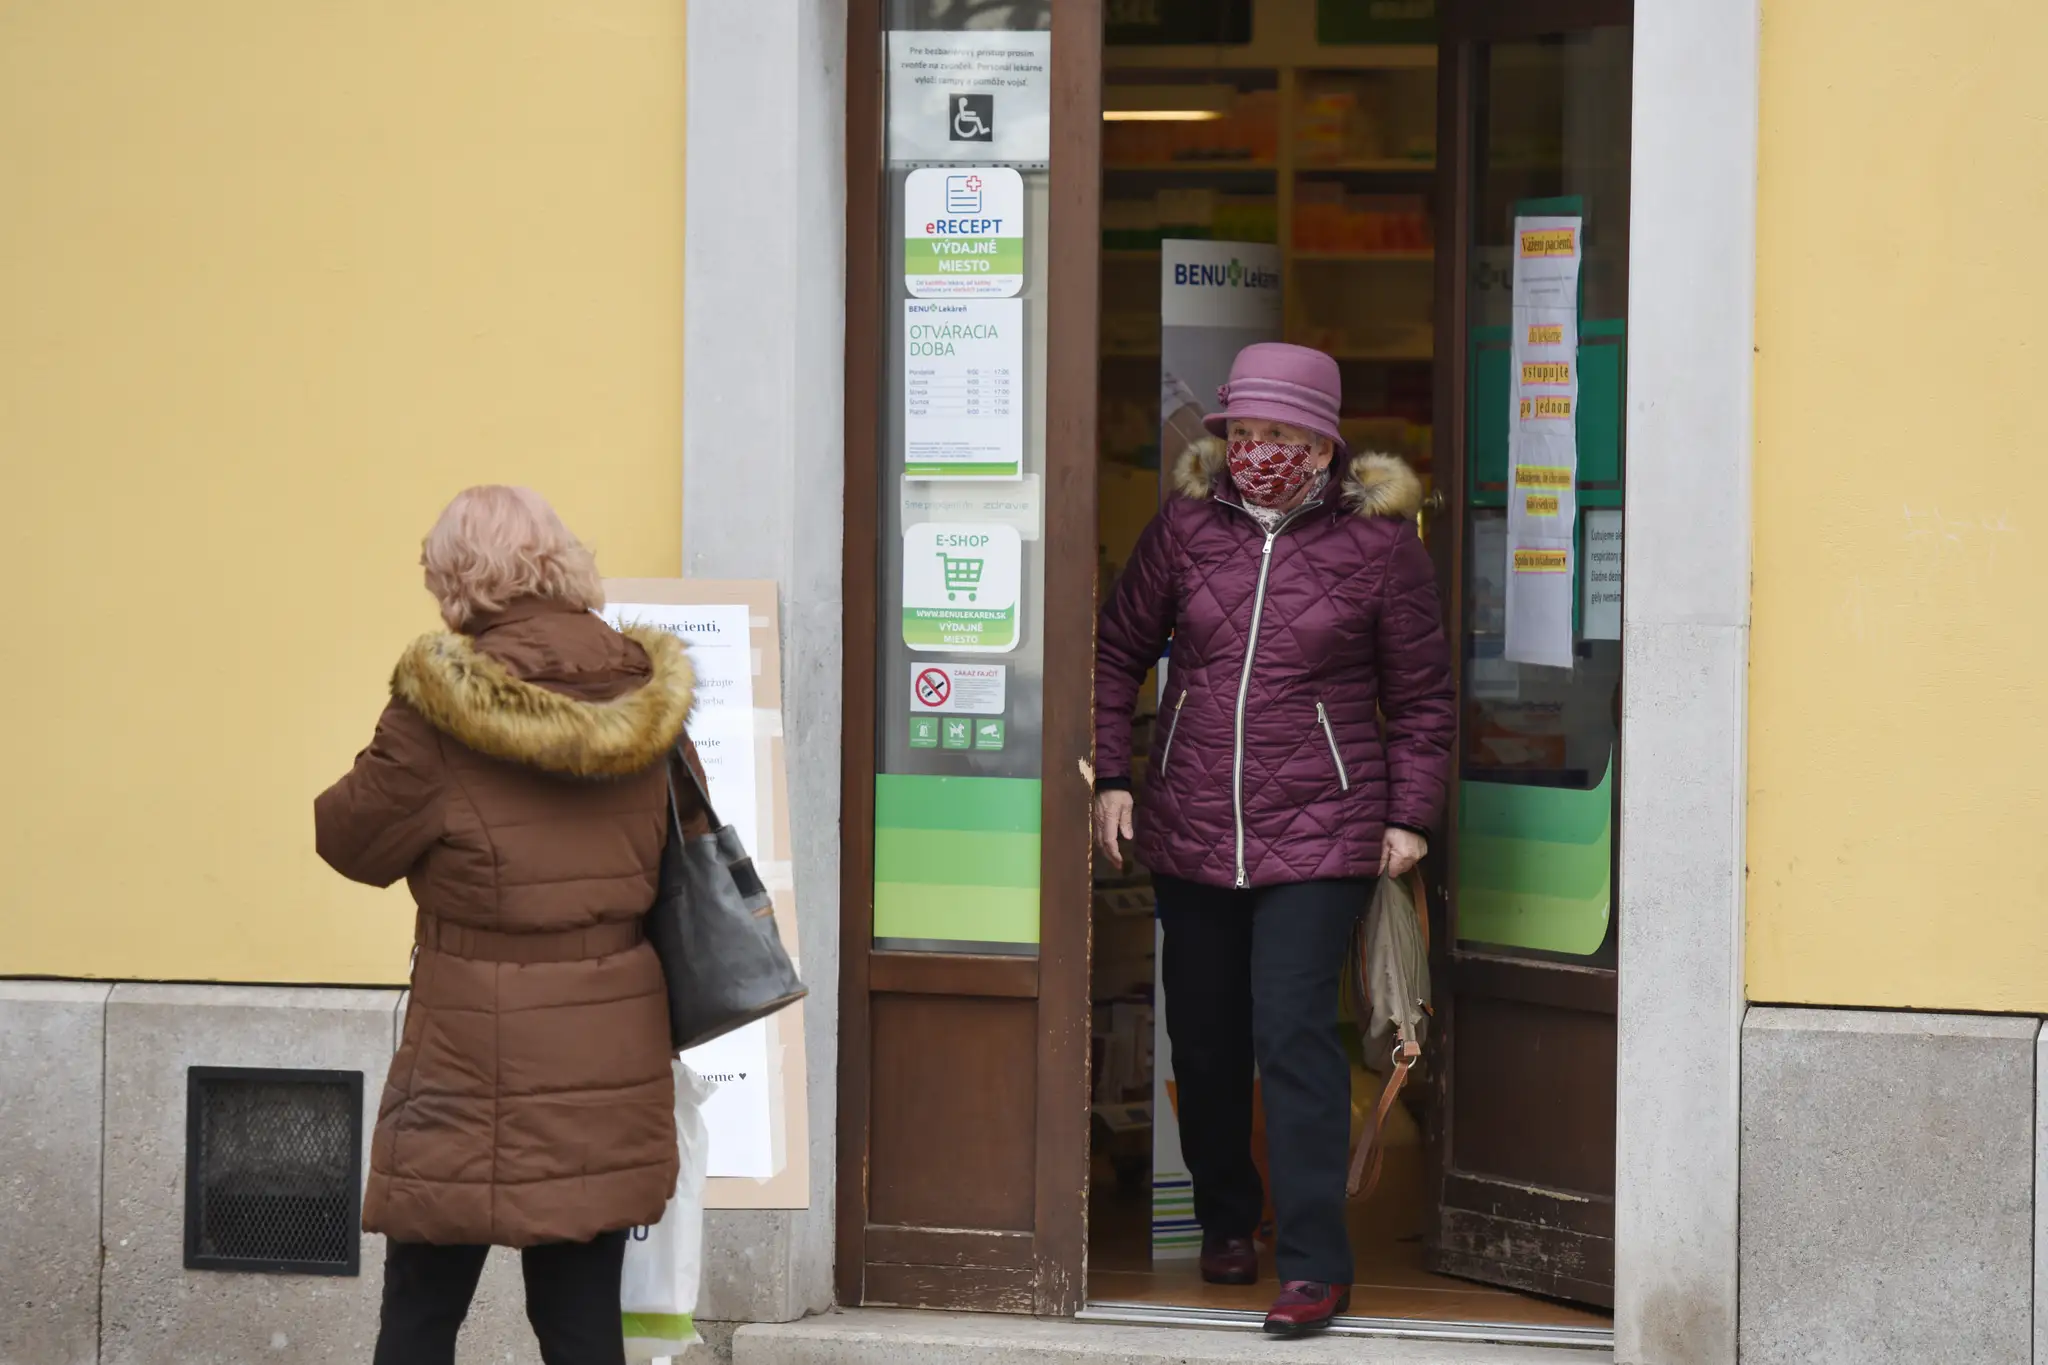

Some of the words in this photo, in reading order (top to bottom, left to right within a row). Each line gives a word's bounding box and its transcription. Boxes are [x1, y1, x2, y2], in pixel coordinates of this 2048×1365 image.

[926, 219, 1003, 234] eRECEPT
[931, 239, 998, 254] VÝDAJNÉ
[938, 259, 990, 272] MIESTO
[1175, 264, 1225, 286] BENU
[938, 303, 967, 312] Lekáreň
[909, 320, 998, 339] OTVÁRACIA
[909, 342, 956, 356] DOBA
[1523, 363, 1569, 382] vstupujte
[1520, 401, 1531, 418] po
[1534, 397, 1571, 417] jednom
[936, 534, 989, 548] E-SHOP
[916, 610, 1006, 620] WWW.BENULEKAREN.SK
[658, 620, 721, 633] pacienti,
[939, 620, 983, 632] VÝDAJNÉ
[943, 635, 979, 644] MIESTO
